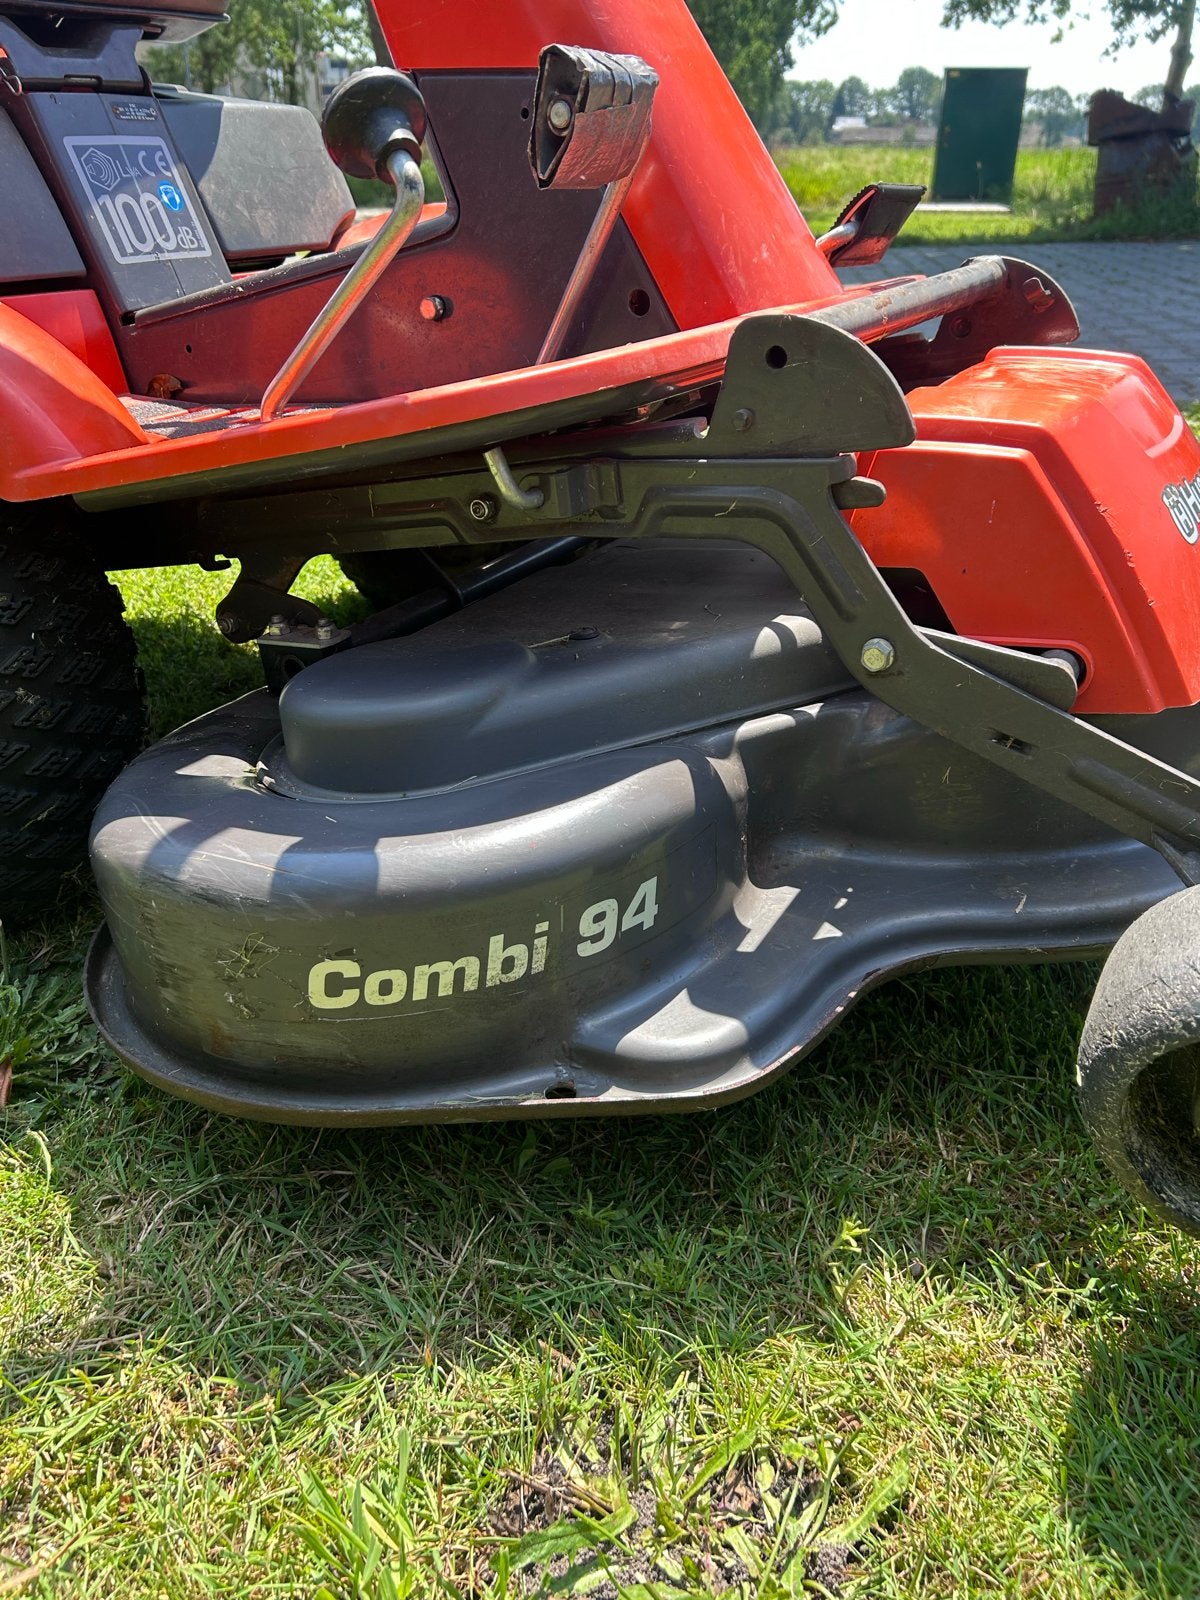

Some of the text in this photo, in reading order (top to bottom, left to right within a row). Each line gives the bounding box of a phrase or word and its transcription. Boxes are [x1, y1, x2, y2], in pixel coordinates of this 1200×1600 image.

[98, 192, 177, 253] 100
[177, 226, 199, 249] dB
[308, 876, 659, 1009] Combi 94
